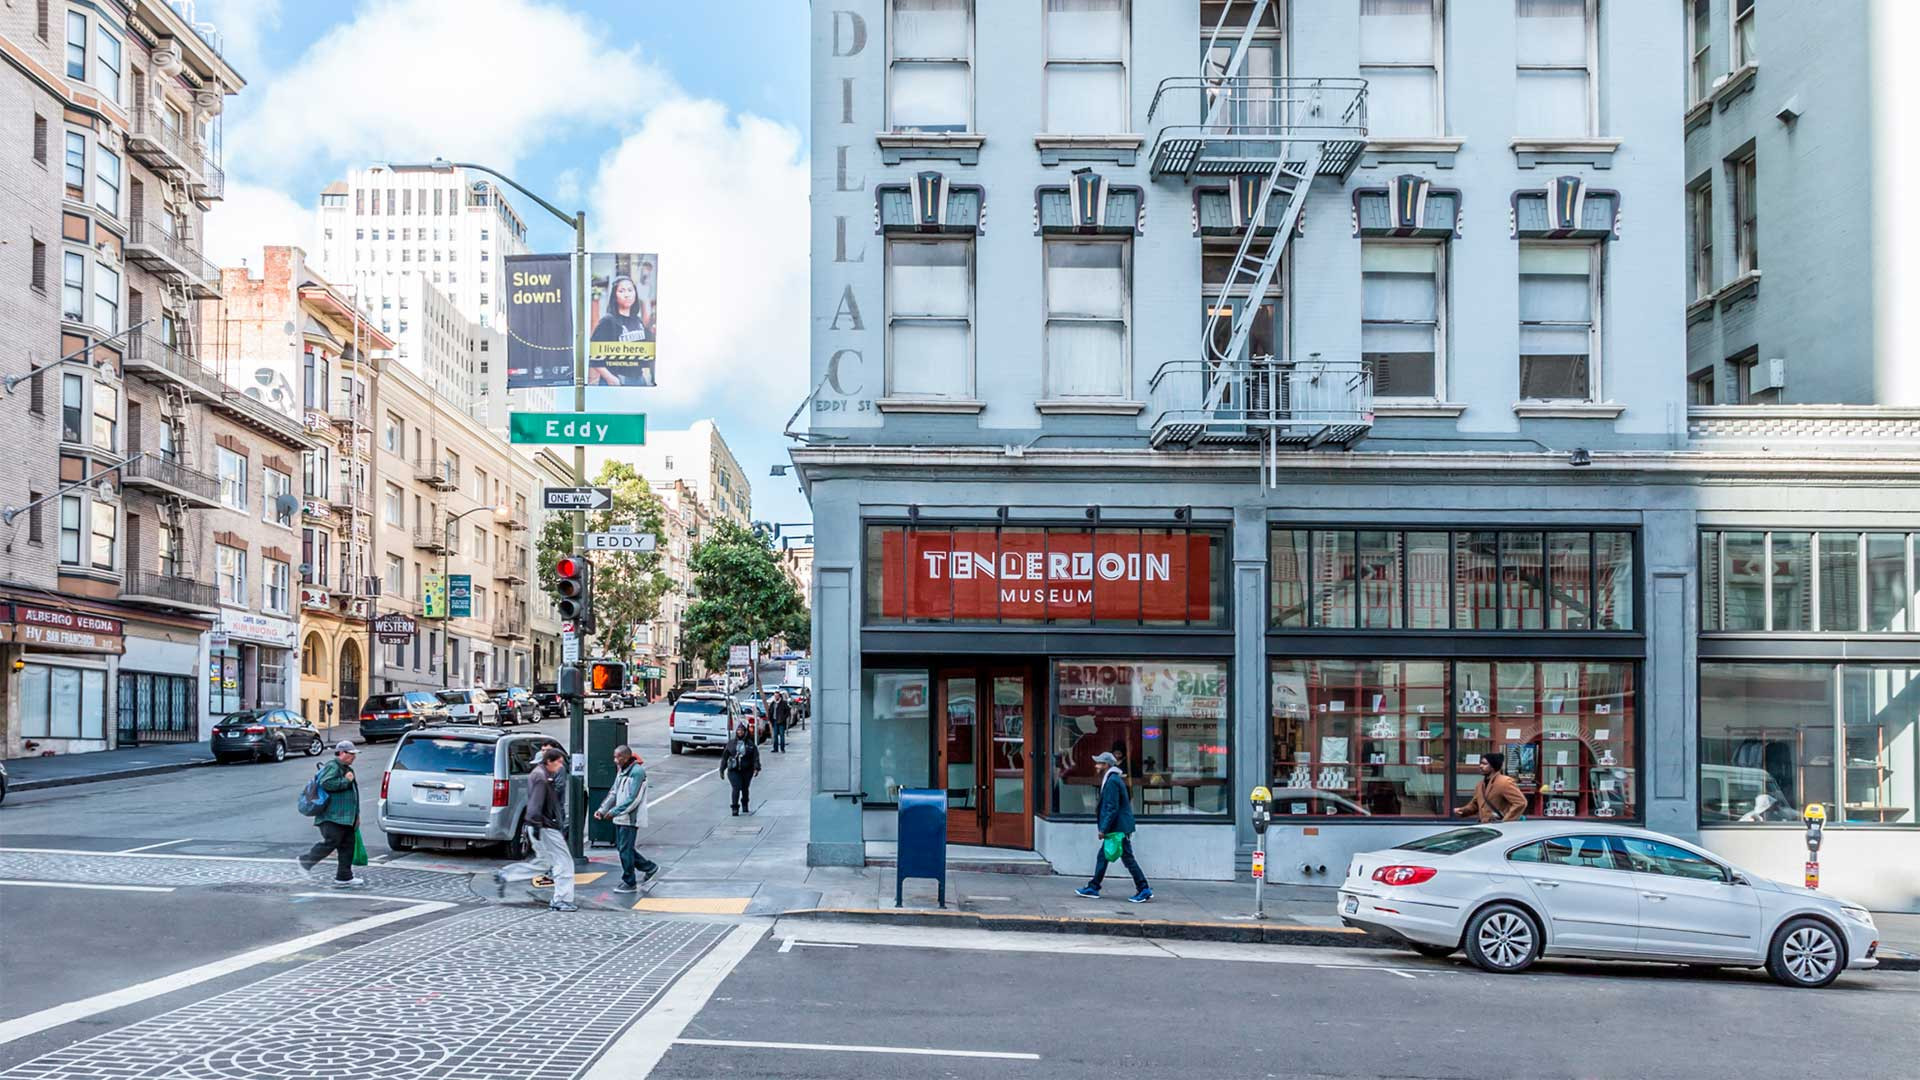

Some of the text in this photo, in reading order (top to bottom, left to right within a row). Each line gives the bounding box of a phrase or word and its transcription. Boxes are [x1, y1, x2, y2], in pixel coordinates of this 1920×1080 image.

[512, 271, 552, 287] Slow
[512, 289, 562, 305] down!
[604, 344, 621, 354] live
[815, 399, 848, 412] EDDY
[545, 420, 609, 441] Eddy
[550, 494, 591, 503] ONE WAY
[596, 536, 645, 548] EDDY
[923, 551, 1170, 582] TENDERLOIN
[1001, 589, 1093, 603] MUSEUM
[25, 609, 113, 631] ALBERGO VERONA
[375, 621, 415, 632] WESTERN
[26, 626, 42, 642] HV
[798, 667, 810, 676] 25
